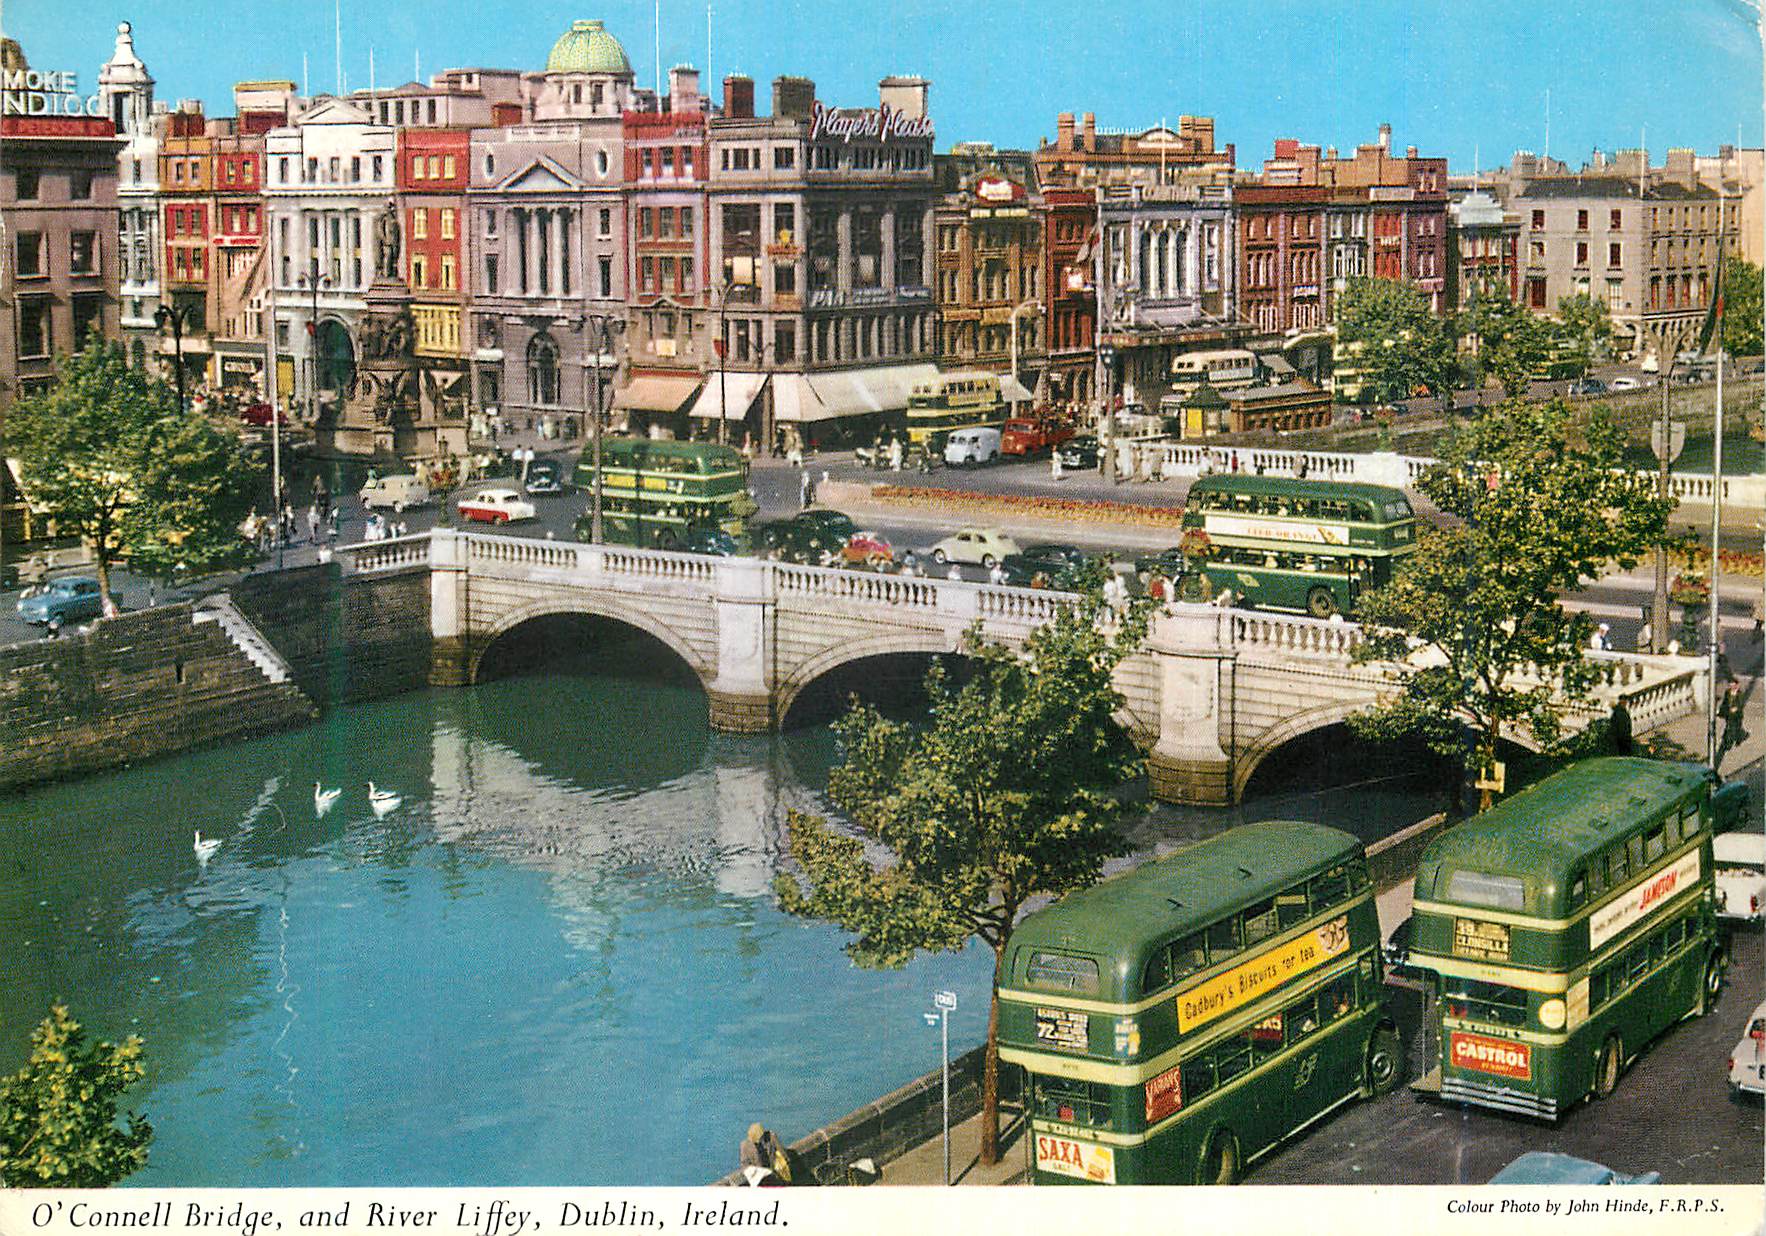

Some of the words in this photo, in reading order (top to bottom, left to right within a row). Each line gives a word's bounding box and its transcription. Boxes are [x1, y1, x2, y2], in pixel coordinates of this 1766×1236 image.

[1639, 869, 1677, 909] JAMESON
[1185, 986, 1234, 1020] Cadbury's
[1239, 963, 1278, 994] Biscuits
[1299, 945, 1315, 963] tea
[1456, 1041, 1527, 1068] CASTROL
[1039, 1137, 1084, 1169] SAXA
